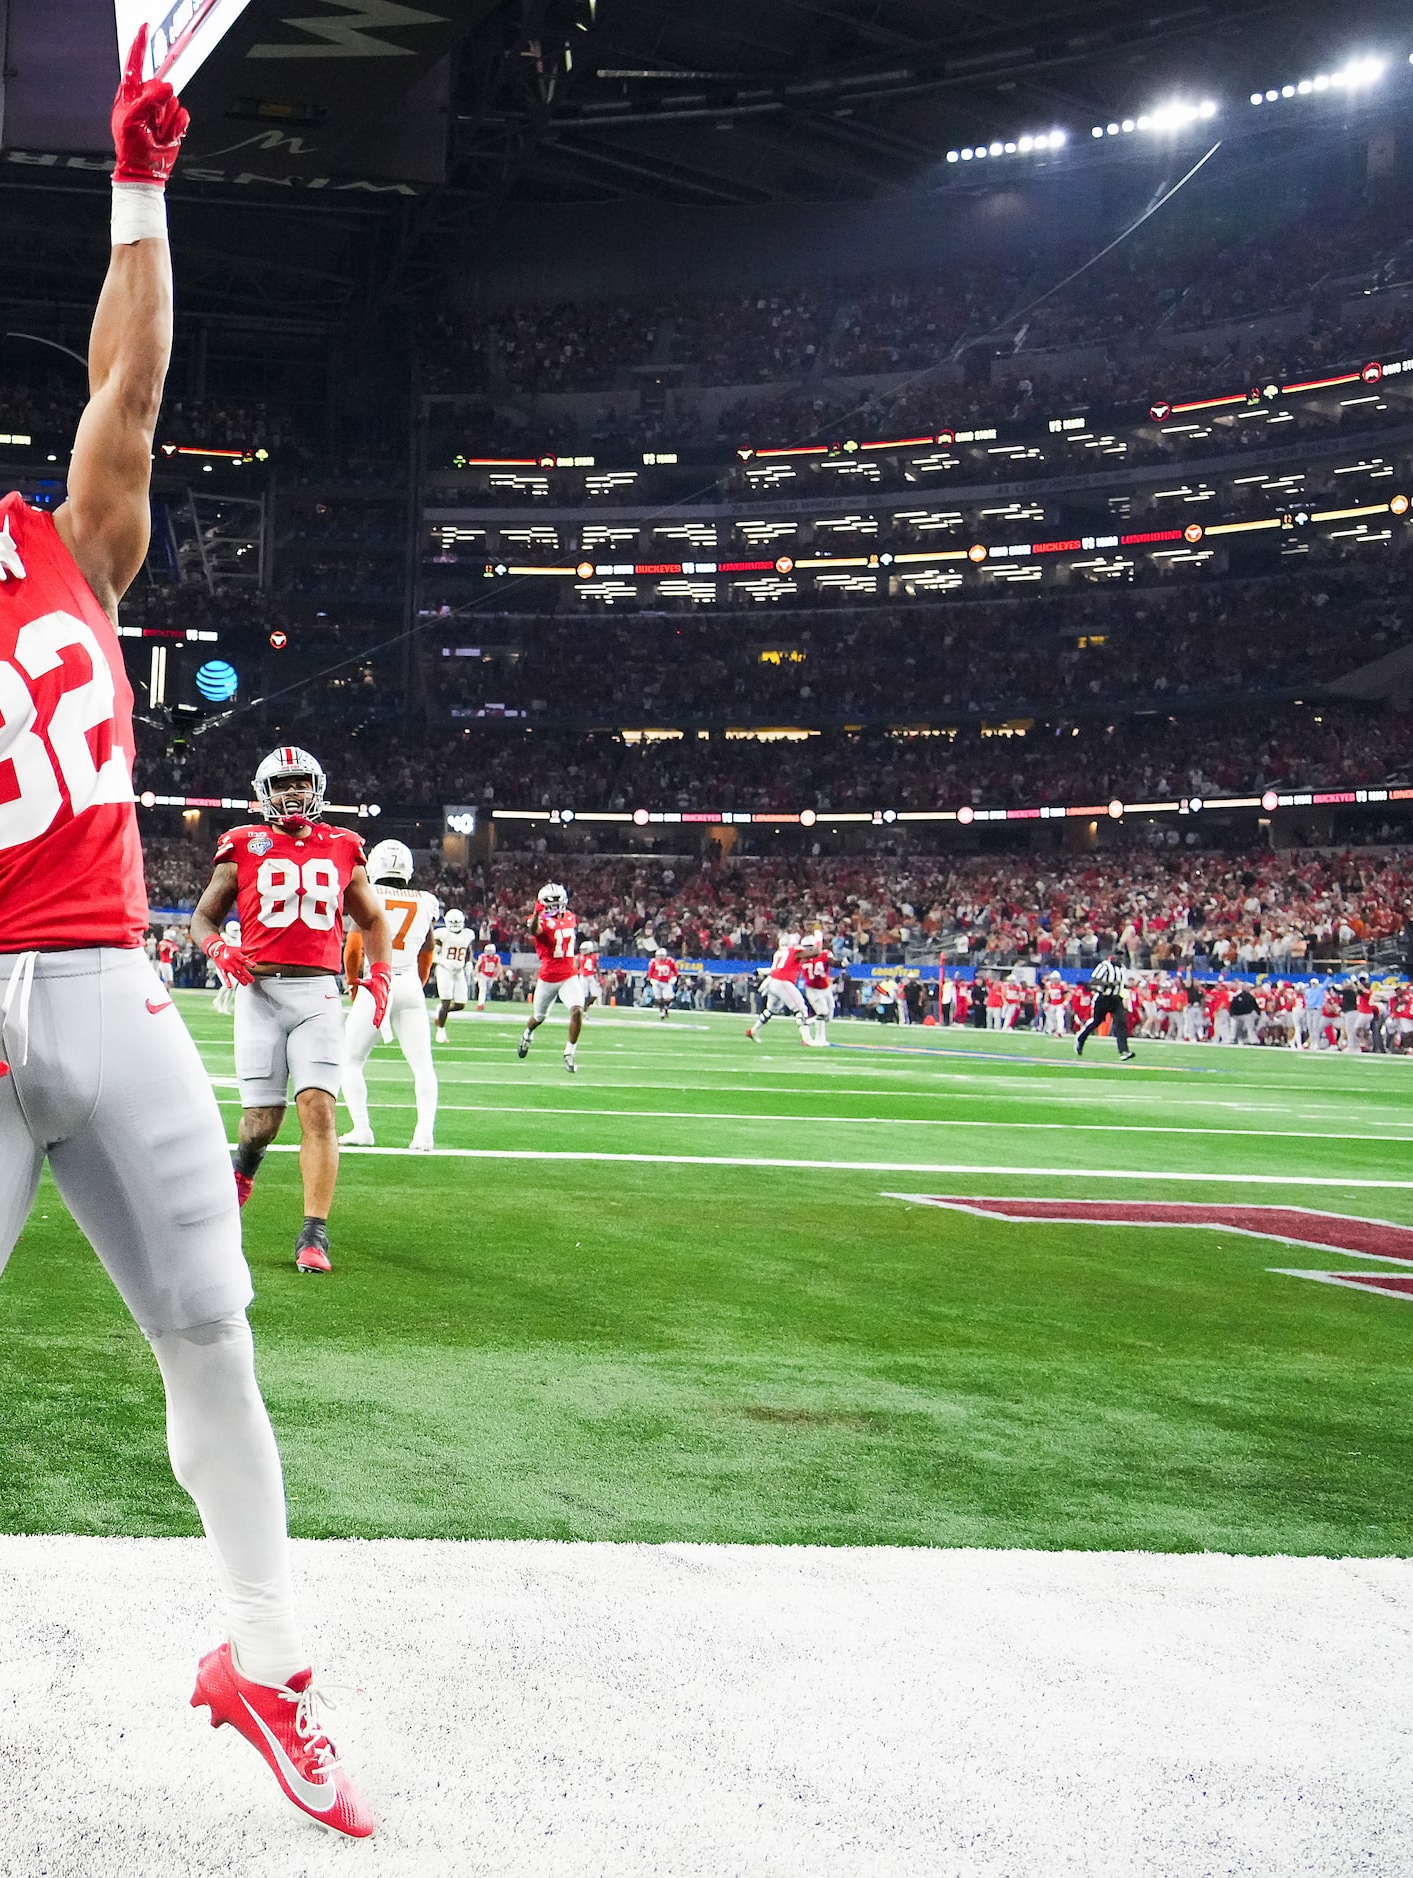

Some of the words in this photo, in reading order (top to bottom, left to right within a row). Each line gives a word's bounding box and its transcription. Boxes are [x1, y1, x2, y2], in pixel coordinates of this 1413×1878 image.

[1032, 538, 1081, 554] BUCKEYES
[1121, 530, 1183, 545] LONGHORNS
[635, 564, 681, 575] BUCKEYES
[256, 858, 340, 928] 88
[385, 899, 418, 951] 7
[553, 928, 577, 958] 17
